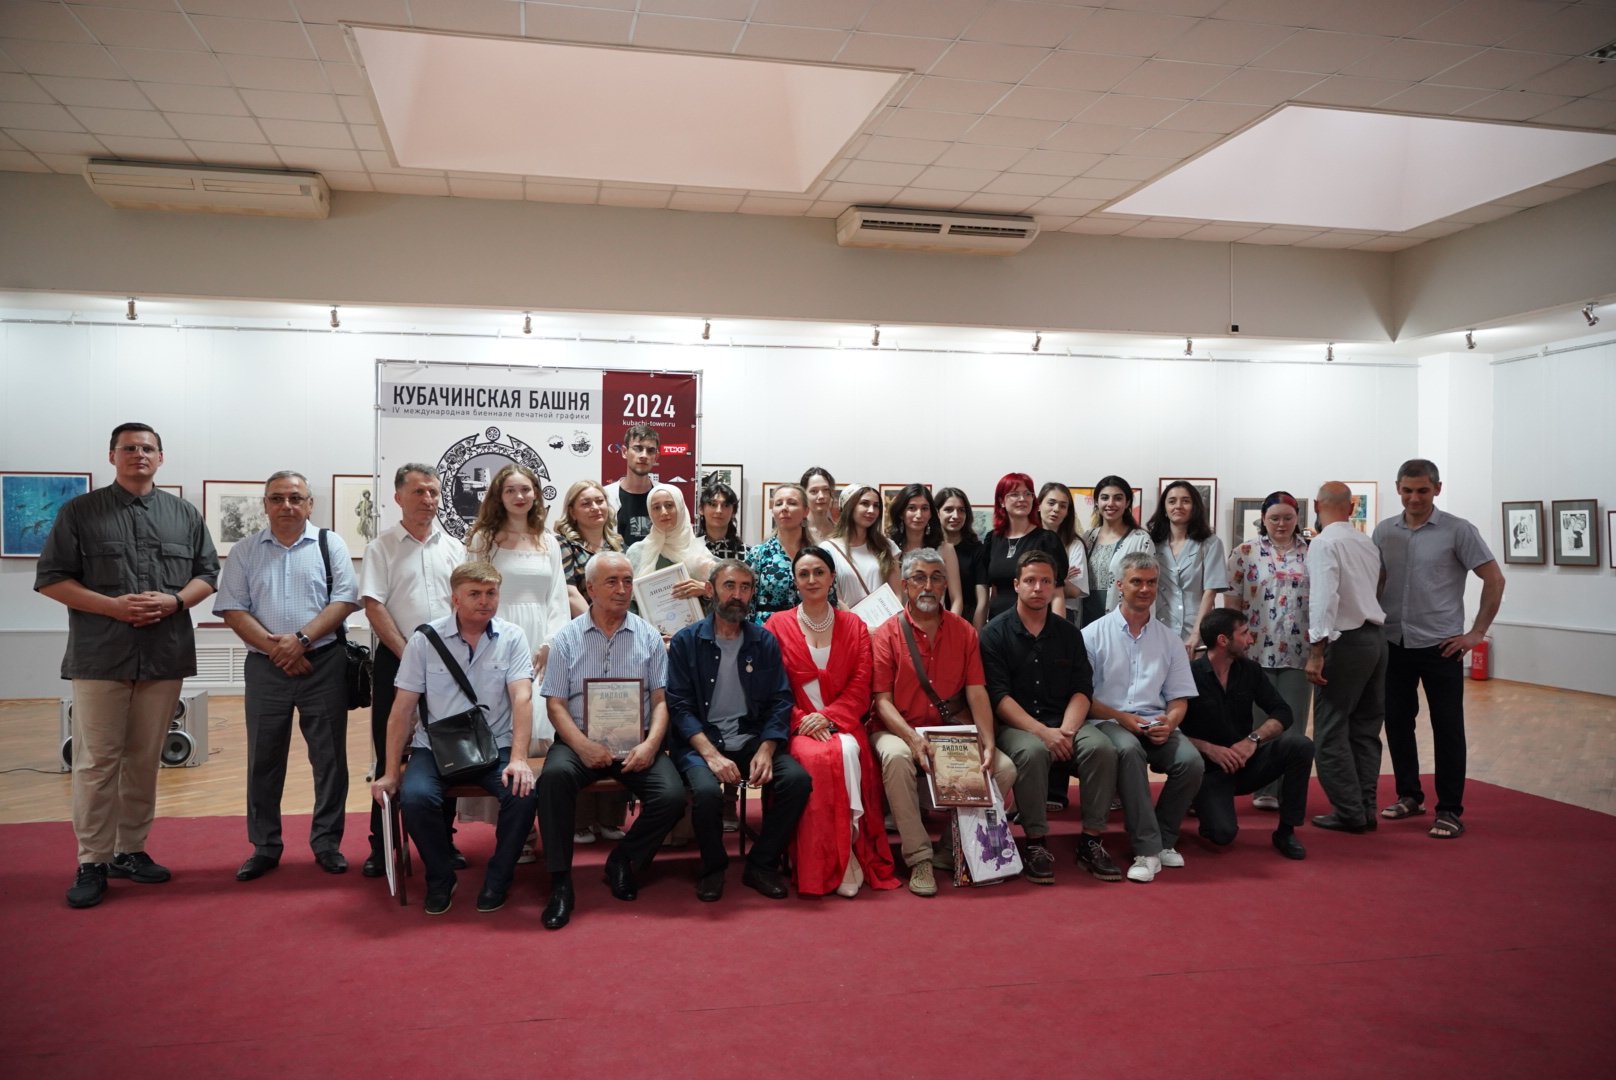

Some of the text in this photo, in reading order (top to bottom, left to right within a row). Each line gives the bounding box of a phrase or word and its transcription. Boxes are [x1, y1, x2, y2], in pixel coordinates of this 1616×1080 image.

[393, 385, 590, 411] КУБАЧИНСКАЯ БАШНЯ
[623, 393, 676, 418] 2024
[392, 406, 590, 421] IV международная биеннале печатной графики
[622, 419, 676, 428] kubachi-tower.ru
[649, 583, 674, 597] ДИПЛО
[600, 691, 629, 700] ДИПЛОМ
[942, 744, 969, 752] ДИПЛОМ
